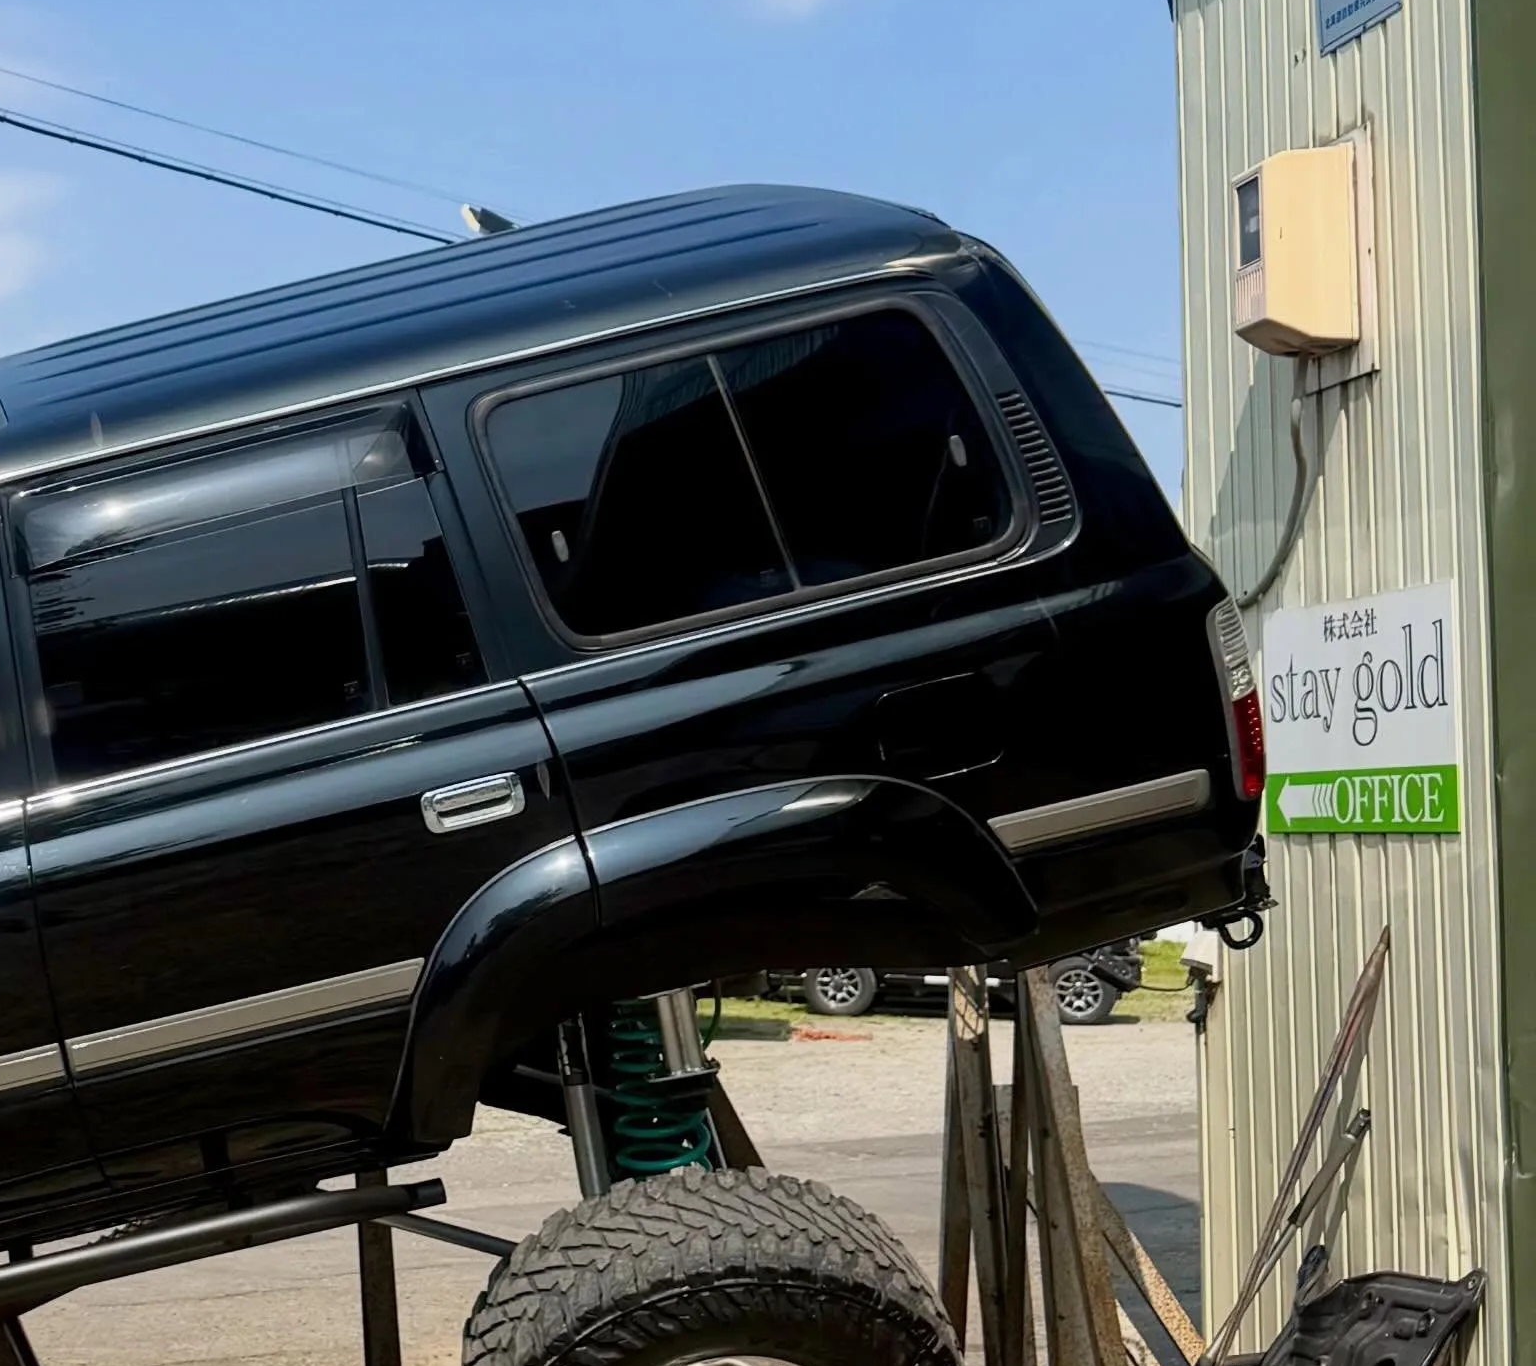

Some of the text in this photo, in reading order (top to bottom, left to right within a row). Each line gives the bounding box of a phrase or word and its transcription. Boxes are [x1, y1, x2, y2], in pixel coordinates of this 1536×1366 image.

[1323, 607, 1378, 643] 株式会社
[1270, 618, 1448, 746] stay gold
[1333, 773, 1445, 824] OFFICE
